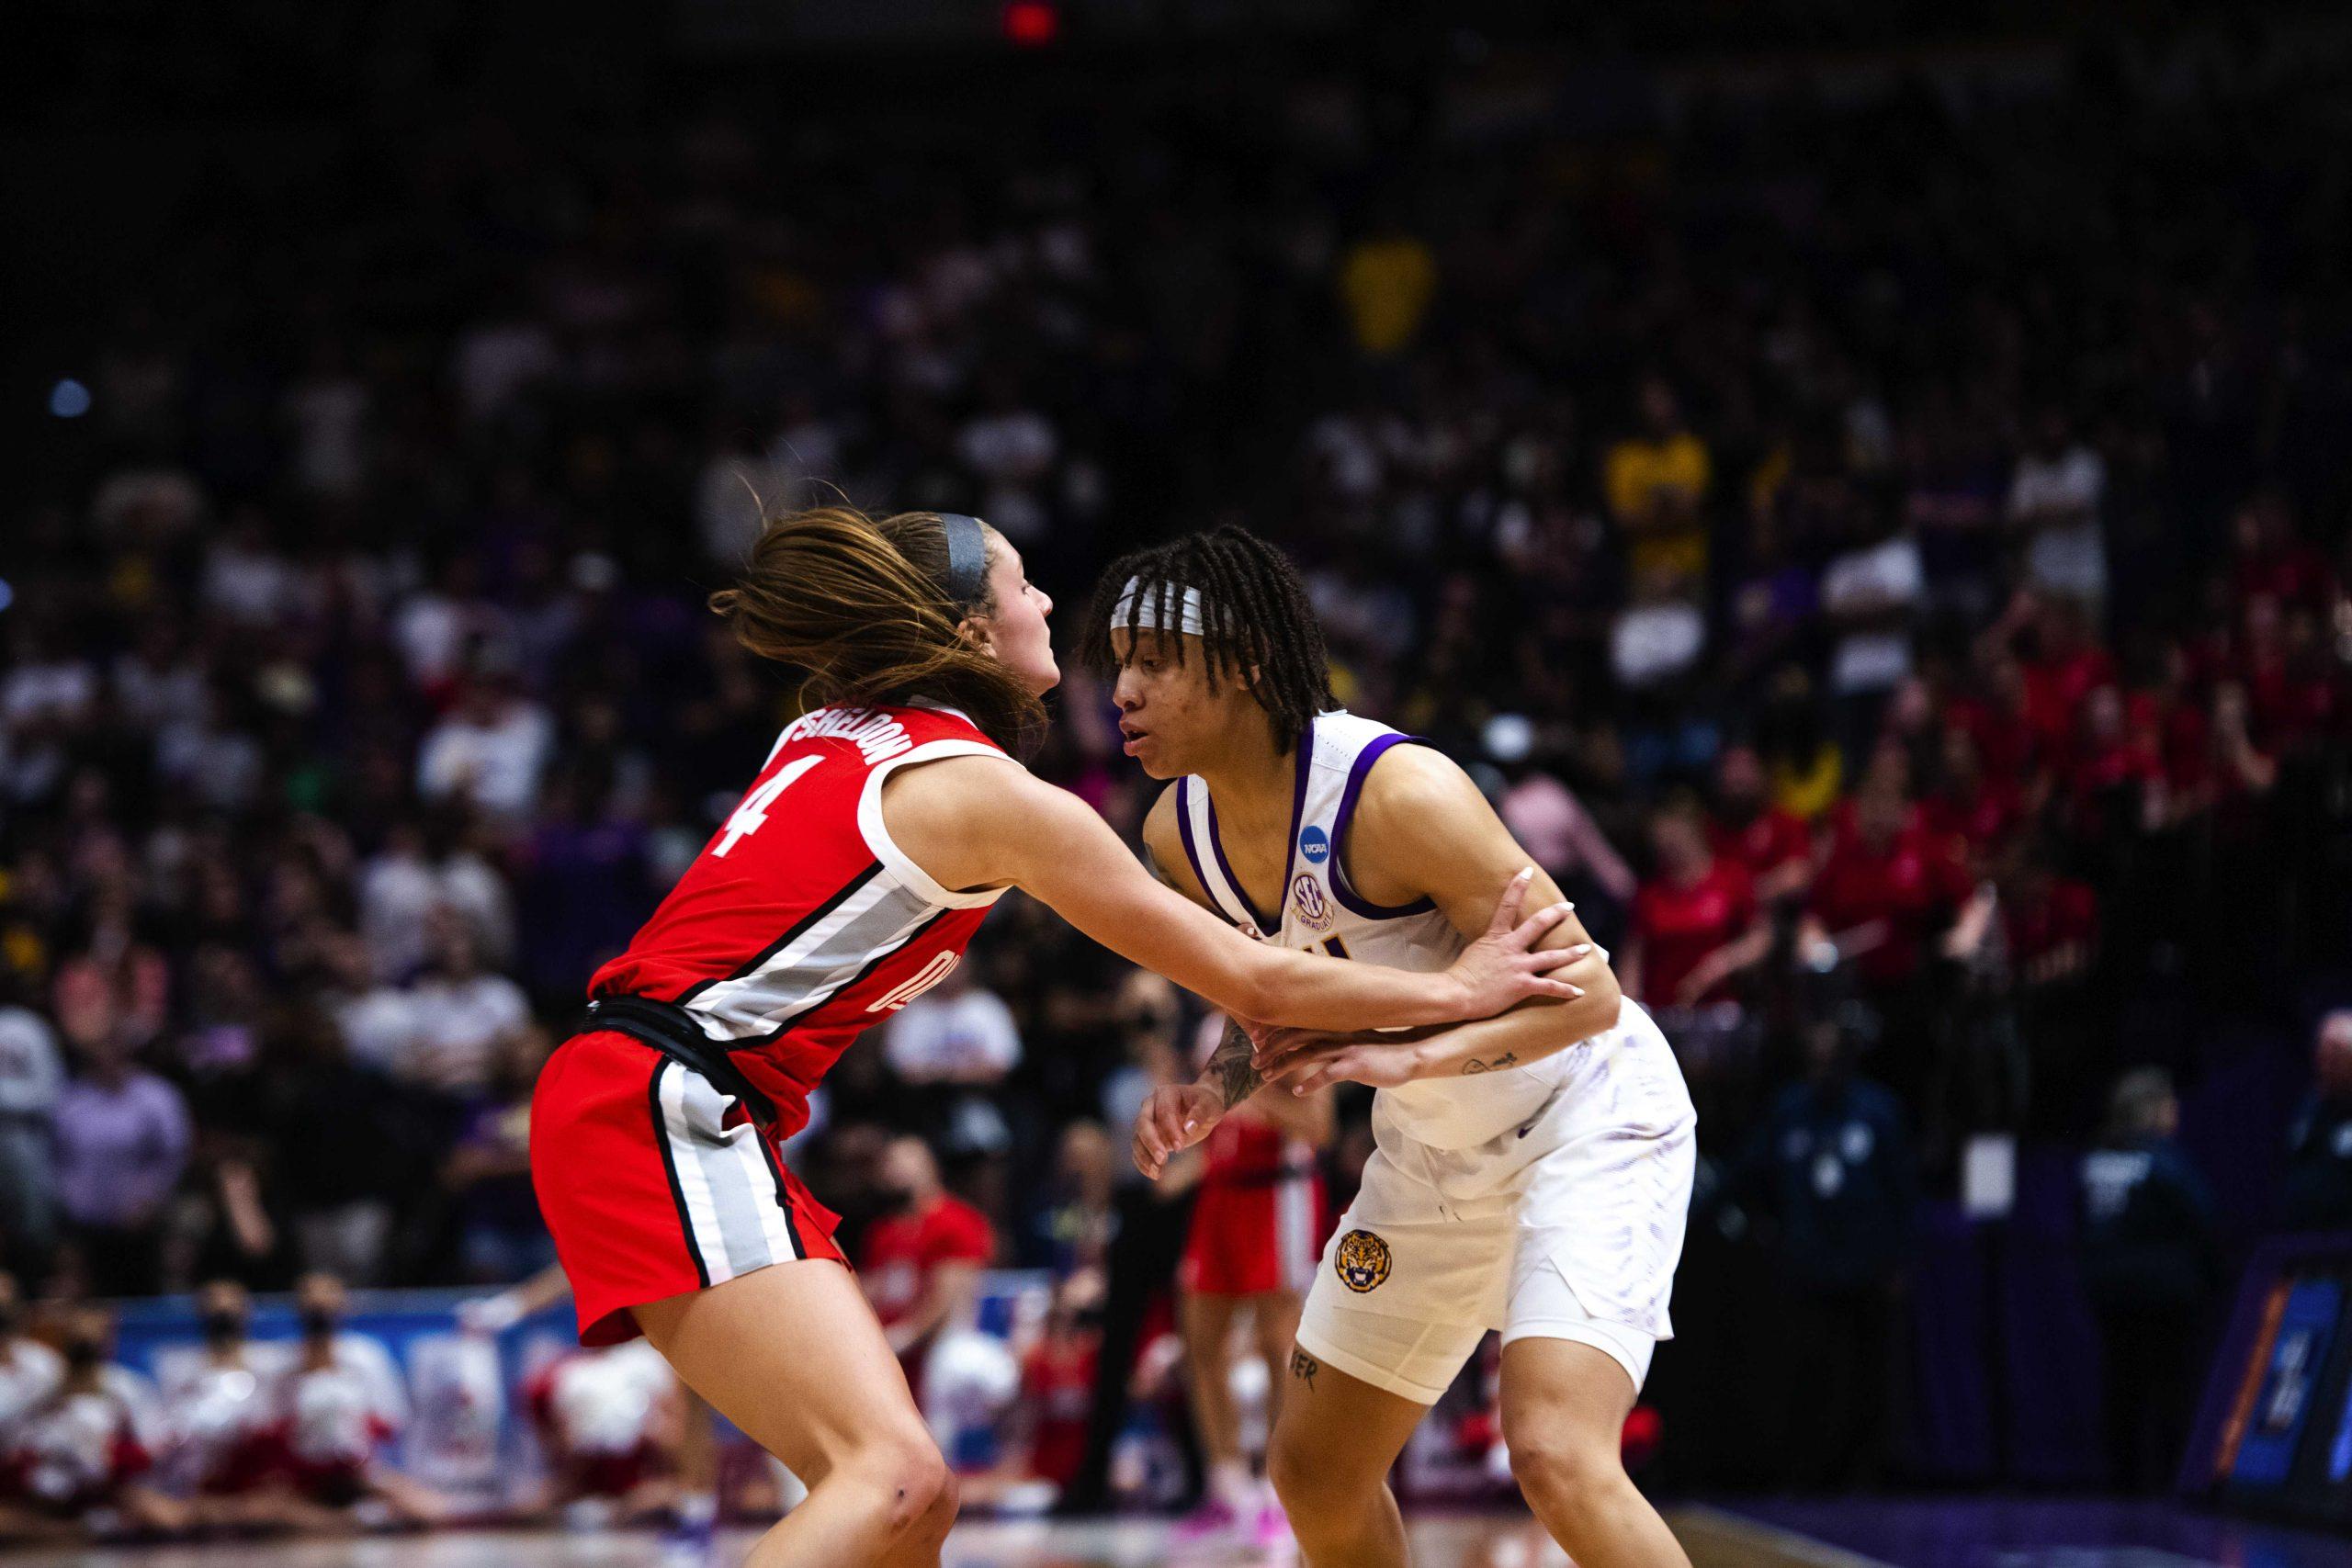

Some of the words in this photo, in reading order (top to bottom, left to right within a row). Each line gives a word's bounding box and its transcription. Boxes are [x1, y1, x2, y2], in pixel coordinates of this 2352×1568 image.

[791, 707, 913, 766] SHELDON
[710, 753, 827, 858] 4
[1304, 843, 1327, 854] NCAA
[1295, 875, 1324, 917] SEC
[1300, 911, 1331, 931] GRADUATE
